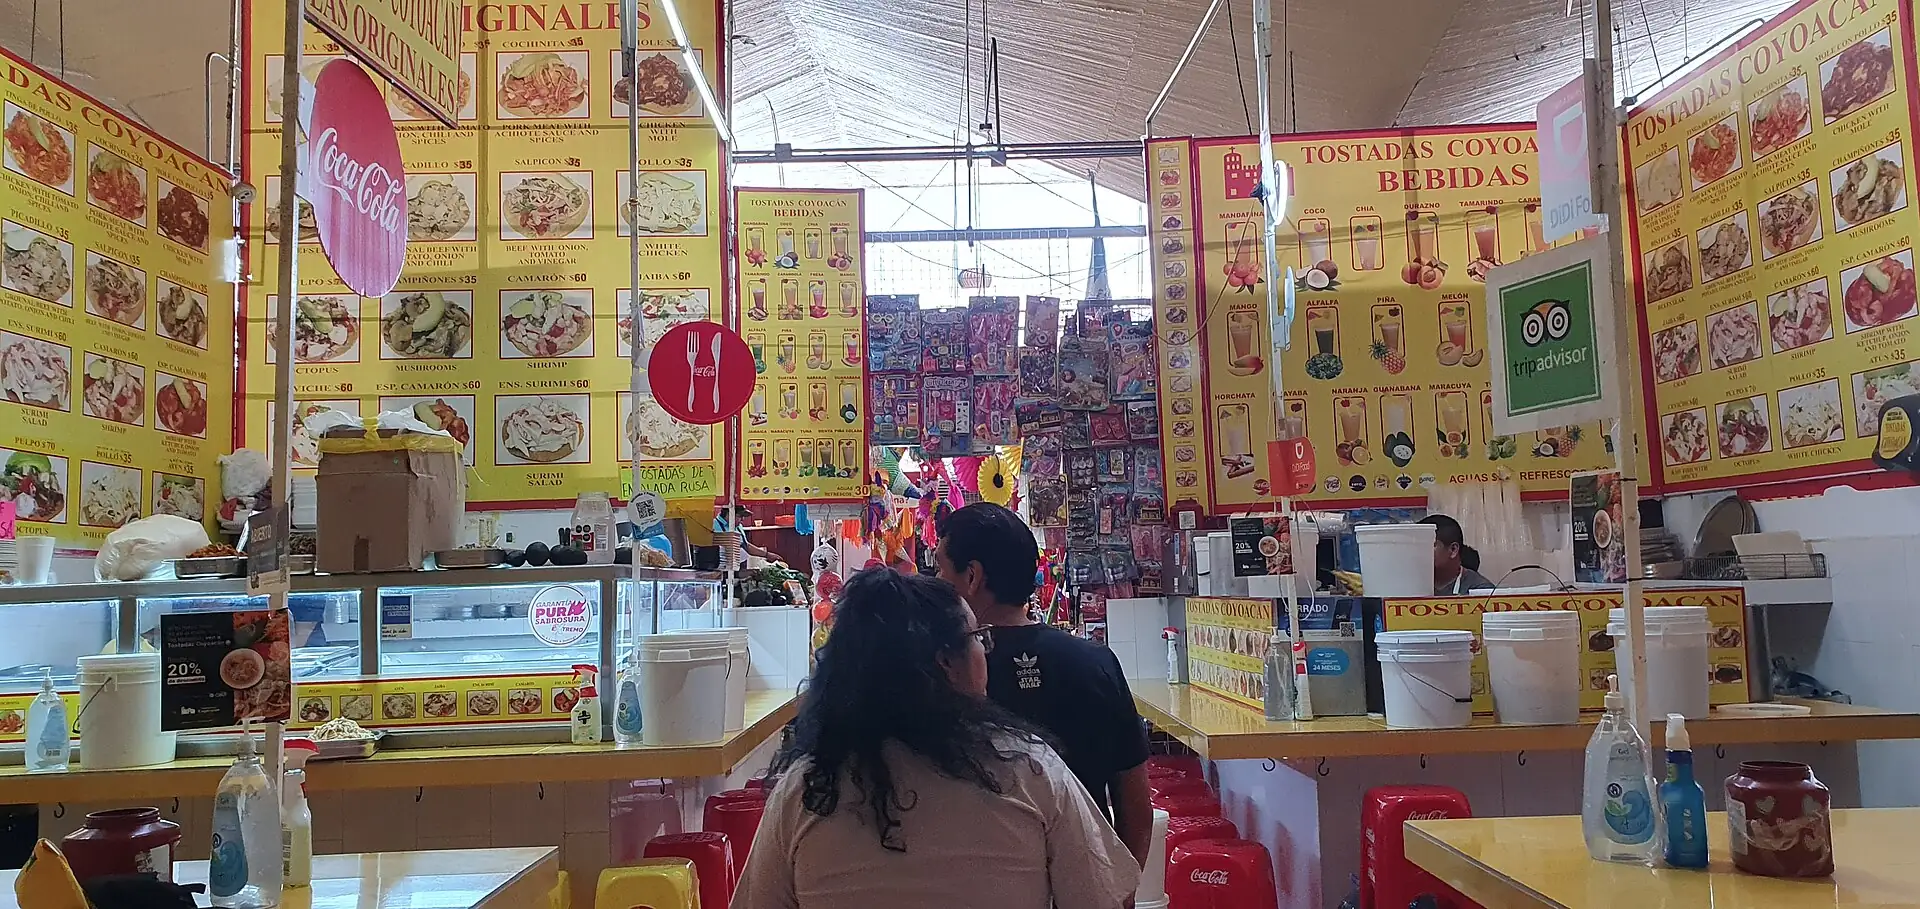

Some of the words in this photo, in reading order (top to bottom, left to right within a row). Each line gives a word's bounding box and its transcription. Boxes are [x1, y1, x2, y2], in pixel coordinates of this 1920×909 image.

[462, 3, 651, 32] IGINALES
[502, 39, 565, 48] COCHINITA
[567, 36, 584, 47] $35
[322, 43, 340, 53] $35
[353, 4, 457, 116] ORIGINALES
[1631, 68, 1732, 148] TOSTADAS
[1832, 114, 1866, 136] CHICKEN
[1867, 103, 1890, 120] WITH
[639, 121, 686, 129] CHICKEN
[1849, 121, 1873, 137] MOLE
[541, 130, 573, 138] SAUCE
[574, 129, 599, 137] AND
[650, 128, 677, 136] WITH
[411, 138, 447, 146] SPICES
[529, 136, 564, 144] SPICES
[648, 135, 678, 143] MOLE
[81, 105, 230, 197] COYOACAN
[1301, 140, 1434, 164] TOSTADAS
[1447, 136, 1538, 158] COYOA
[1832, 138, 1885, 166] CHAMPIÑONES
[1886, 128, 1901, 144] $35
[403, 160, 449, 169] CADILLO
[454, 160, 473, 170] $35
[515, 157, 562, 166] SALPICON
[564, 157, 581, 168] $35
[638, 157, 672, 166] OLLO
[674, 157, 692, 168] $35
[315, 127, 403, 234] Coca-Cola
[1376, 163, 1529, 192] BEBIDAS
[1763, 175, 1799, 197] SALPICON
[750, 199, 795, 208] TOSTADAS
[798, 199, 847, 208] COYOACÁN
[1404, 202, 1440, 210] DURAZNO
[1459, 199, 1504, 207] TAMARINDO
[774, 208, 824, 218] BEBIDAS
[1303, 207, 1326, 215] COCO
[1355, 205, 1375, 213] CHIA
[1219, 210, 1265, 219] MANDARINA
[10, 209, 53, 231] PICADILLO
[55, 226, 69, 241] $35
[1848, 218, 1896, 240] MUSHROOMS
[451, 245, 478, 253] WITH
[531, 244, 556, 252] WITH
[558, 243, 589, 252] ONION,
[1840, 254, 1856, 266] ESP.
[1896, 237, 1910, 251] $60
[432, 252, 465, 260] ONION
[638, 249, 688, 257] CHICKEN
[397, 275, 457, 285] AMPIÑONES
[459, 275, 477, 285] $35
[507, 272, 566, 282] CAMARÓN
[568, 272, 587, 283] $60
[1377, 295, 1396, 303] PIÑA
[1441, 292, 1469, 300] MELÓN
[1229, 303, 1258, 311] MANGO
[1306, 299, 1339, 307] ALFALFA
[8, 318, 25, 330] ENS.
[26, 323, 54, 338] SURIMI
[1791, 348, 1816, 361] SHRIMP
[527, 361, 568, 369] SHRIMP
[1513, 346, 1587, 378] tripadvisor
[295, 367, 339, 375] CTOPUS
[396, 364, 457, 373] MUSHROOMS
[693, 365, 716, 377] oca-Cola
[1789, 372, 1811, 383] POLLO
[1812, 367, 1826, 380] $35
[334, 383, 353, 393] $60
[376, 382, 398, 392] ESP.
[400, 380, 460, 391] CAMARÓN
[462, 380, 481, 391] $60
[499, 380, 523, 389] ENS.
[526, 380, 568, 389] SURIMI
[570, 379, 589, 389] $60
[1373, 384, 1421, 393] GUANABANA
[1428, 381, 1472, 391] MARACUYA
[1273, 390, 1308, 400] AYABA
[1331, 387, 1368, 395] NARANJA
[1214, 392, 1256, 401] HORCHATA
[21, 407, 49, 419] SURIMI
[22, 417, 48, 428] SALAD
[101, 422, 128, 435] SHRIMP
[14, 435, 42, 450] PULPO
[42, 440, 56, 451] $70
[1811, 446, 1842, 459] CHICKEN
[526, 472, 565, 480] SURIMI
[640, 465, 686, 481] OSTADAS
[691, 465, 705, 480] DE
[1519, 469, 1587, 481] REFRESC
[528, 479, 563, 487] SALAD
[680, 480, 710, 493] RUSA
[855, 485, 869, 497] 30
[1235, 542, 1251, 550] 20%
[536, 601, 585, 618] PURA
[1187, 600, 1219, 616] TOSTADAS
[1221, 601, 1270, 619] COYOACAN
[1388, 600, 1554, 617] TOSTADAS
[1561, 594, 1740, 612] COYACAN
[535, 615, 585, 625] SABROSURA
[167, 662, 202, 677] 20%
[1190, 868, 1229, 886] Coca-Cola
